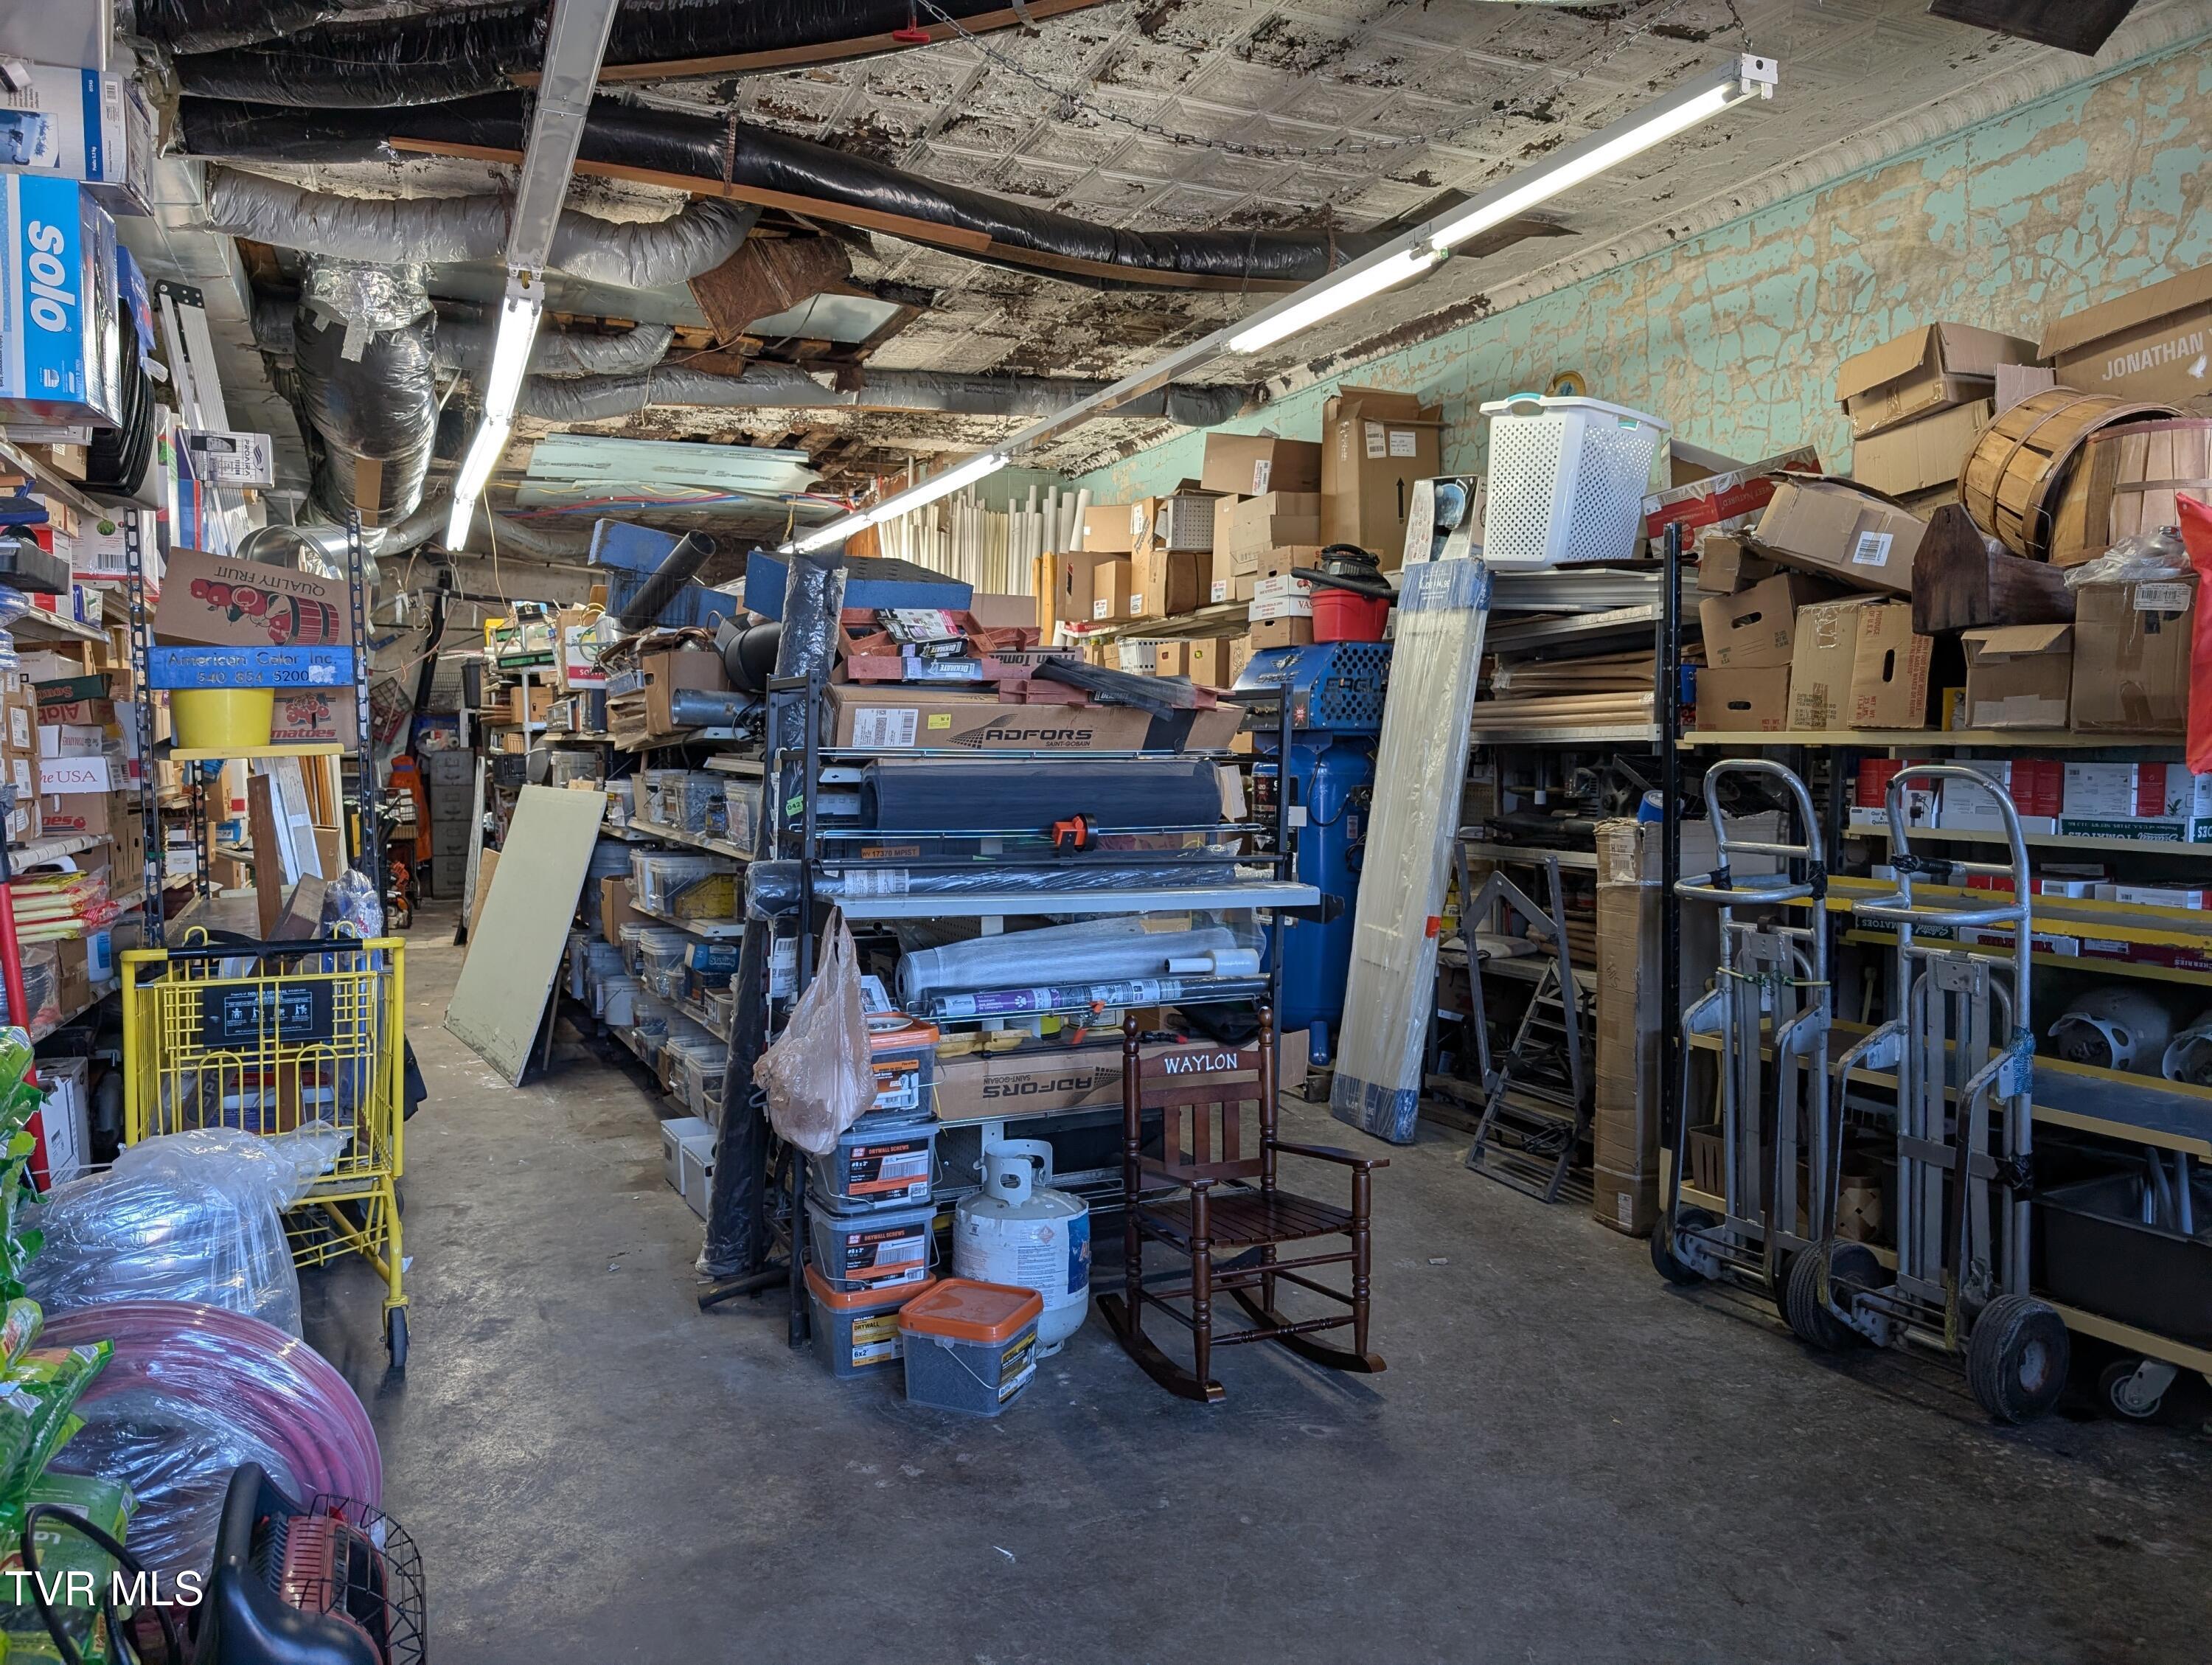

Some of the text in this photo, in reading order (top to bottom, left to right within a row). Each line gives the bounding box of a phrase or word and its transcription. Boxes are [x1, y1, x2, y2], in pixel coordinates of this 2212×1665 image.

[27, 220, 75, 333] solo
[2101, 332, 2204, 381] JONATHAN
[214, 566, 325, 596] QUALITY FRUIT
[1874, 611, 1882, 636] PRODUCE
[931, 644, 957, 654] DEKMATE
[169, 653, 248, 665] American
[310, 651, 337, 664] Inc.
[940, 664, 968, 672] DEKMATE
[197, 671, 226, 684] 540
[273, 670, 310, 683] 5200
[270, 729, 337, 738] matoes
[985, 729, 1093, 741] ADFORS
[41, 771, 97, 782] he USA
[42, 816, 73, 826] oes
[1862, 919, 1899, 930] MATOES
[1164, 1053, 1238, 1074] WAYLON
[984, 1074, 1032, 1085] SAINT-GOBAIN
[983, 1077, 1093, 1099] ADFORS
[854, 1321, 880, 1330] DRYWALL
